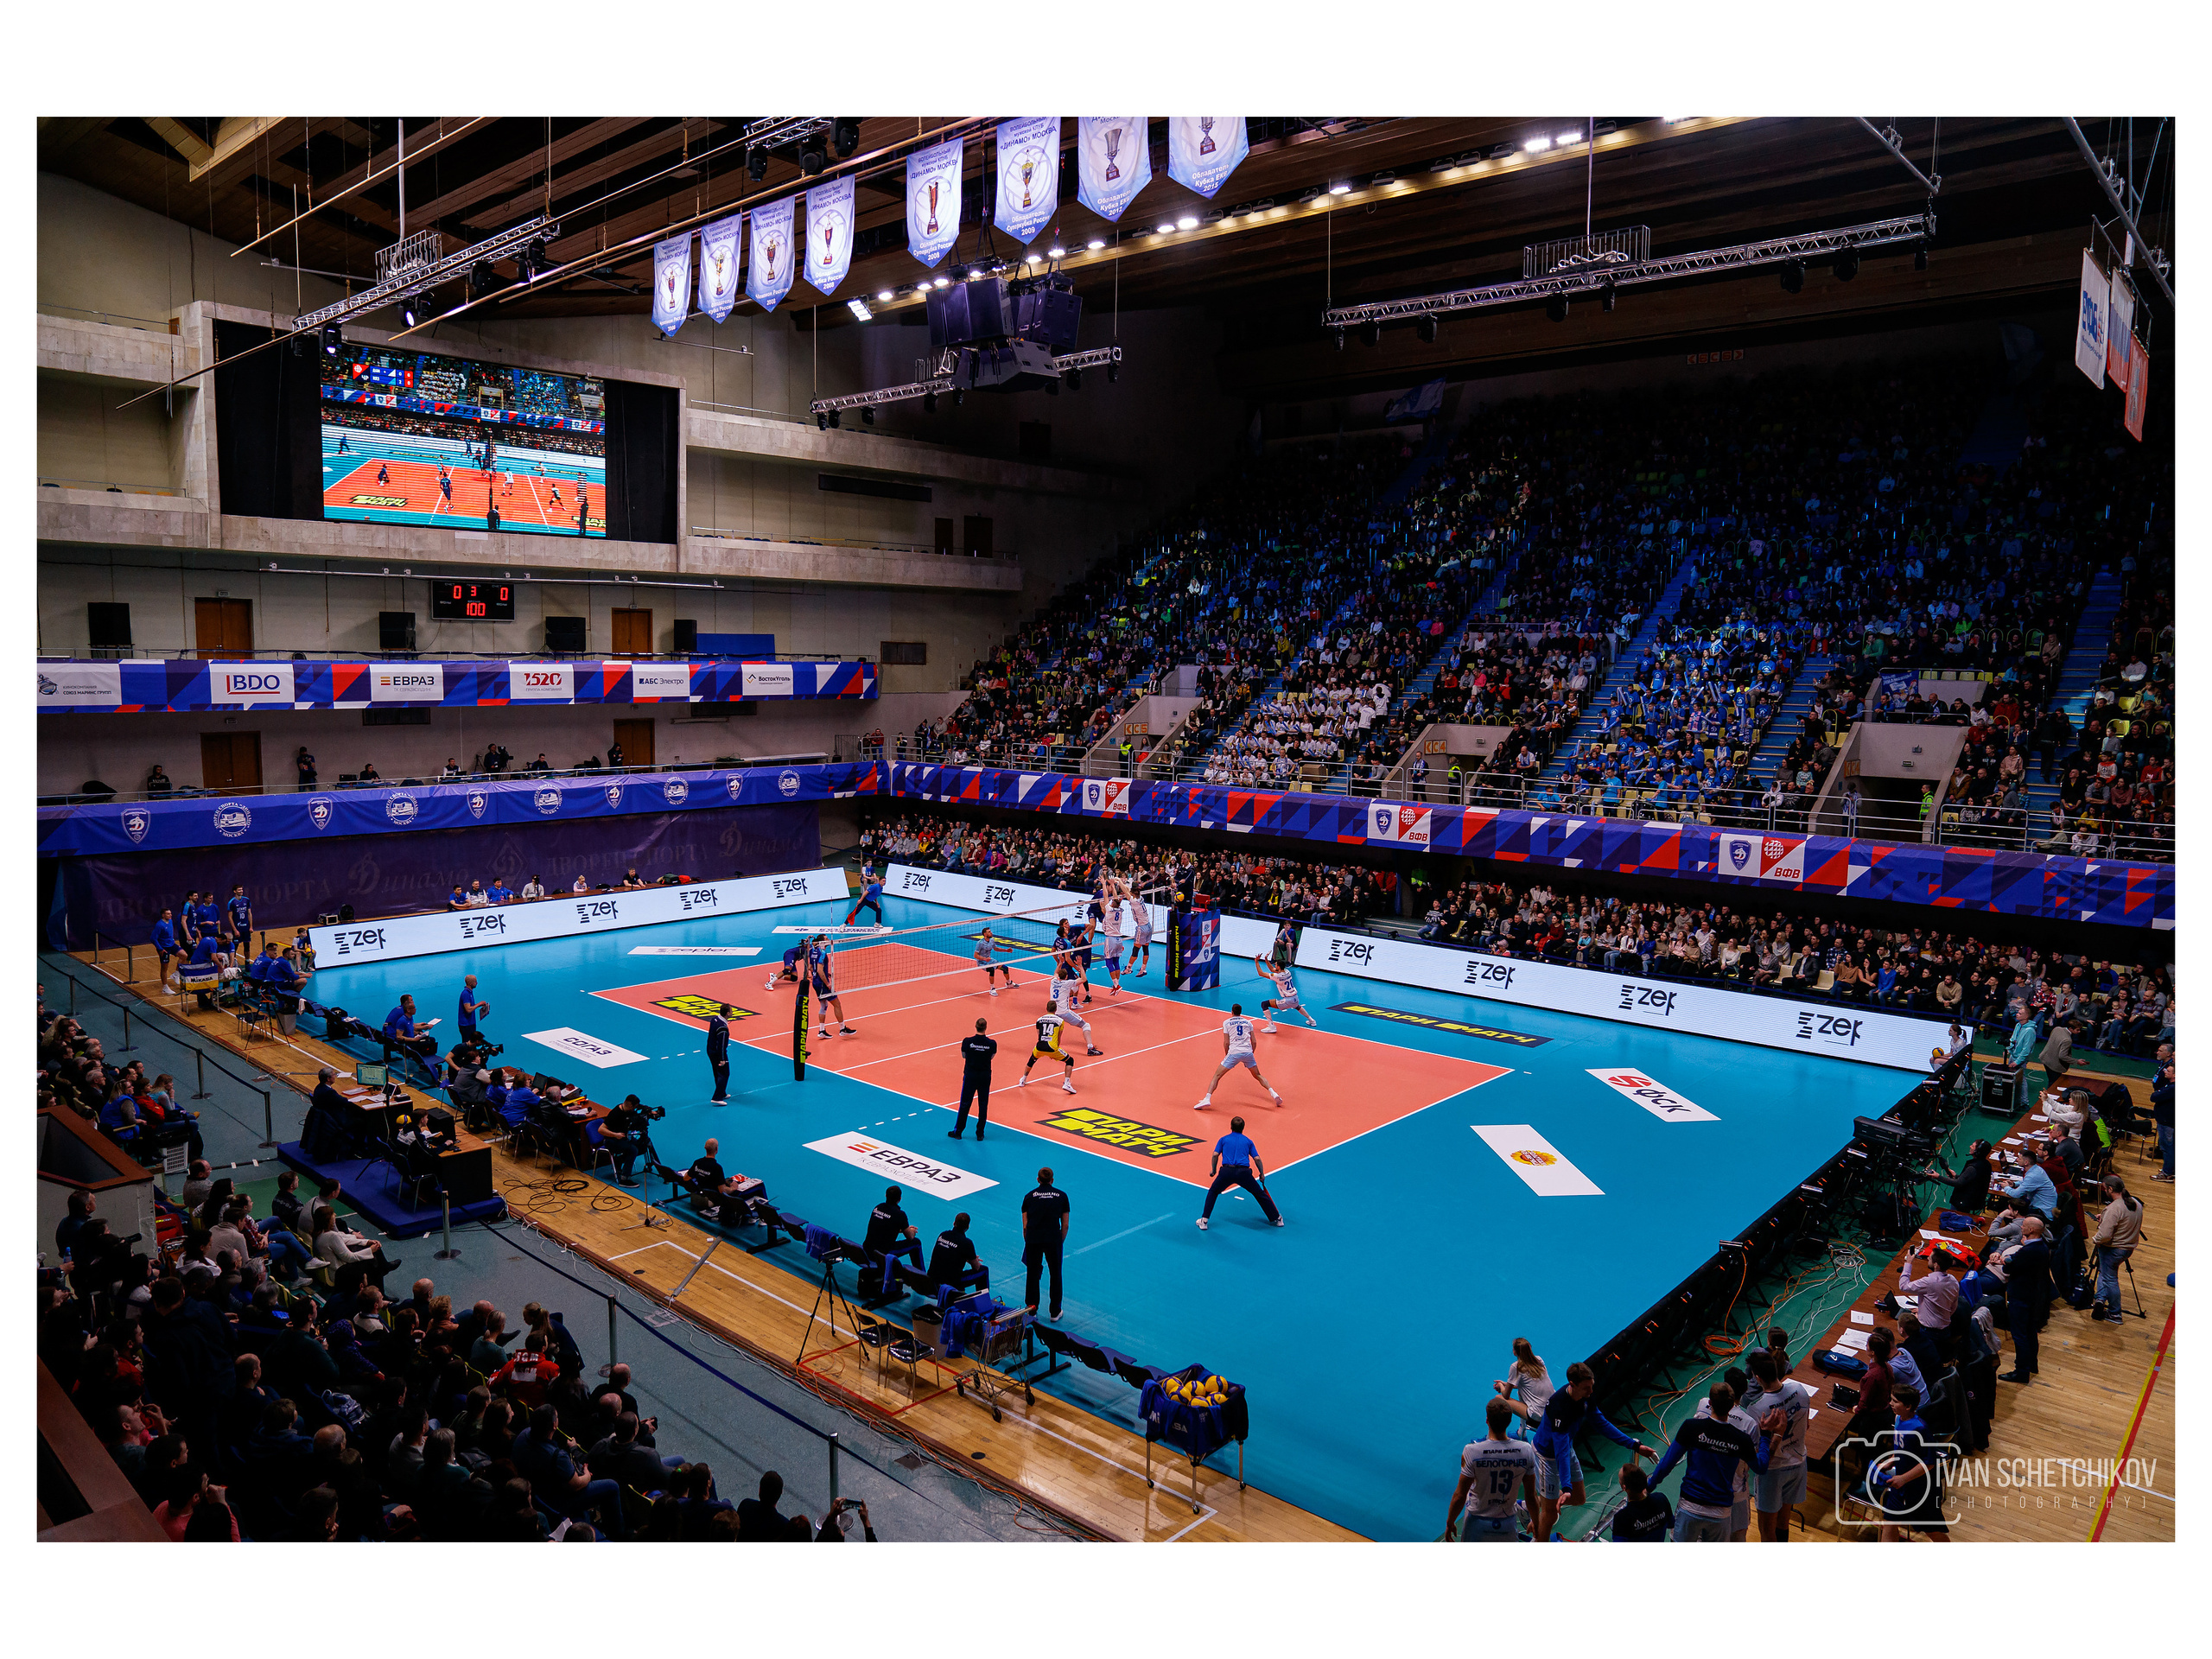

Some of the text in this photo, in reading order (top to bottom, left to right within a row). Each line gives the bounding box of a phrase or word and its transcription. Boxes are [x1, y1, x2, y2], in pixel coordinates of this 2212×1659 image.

[1033, 125, 1057, 140] МОСКВА
[1192, 164, 1229, 180] Обладатель
[1195, 176, 1215, 188] Кубка
[1203, 181, 1218, 192] 2015
[1097, 190, 1132, 204] Обладатель
[1100, 201, 1119, 212] Кубка
[1108, 207, 1122, 216] 2012
[1012, 211, 1046, 223] Обладатель
[1021, 226, 1035, 236] 2009
[927, 251, 940, 261] 2008
[453, 585, 508, 601] 0 3 0
[467, 602, 486, 616] 100
[232, 674, 281, 691] BDO
[393, 676, 435, 686] ЕВРАЗ
[524, 672, 562, 686] 1520
[1134, 724, 1147, 734] С5
[1433, 741, 1446, 752] С4
[1408, 832, 1428, 842] ВФВ
[1774, 868, 1801, 879] ВФВ
[1115, 912, 1119, 921] 8
[1052, 989, 1058, 999] 3
[1042, 1024, 1053, 1035] 14
[1343, 1006, 1537, 1042] ПАРИ МАТЧ
[1236, 1026, 1243, 1036] 9
[563, 1036, 612, 1055] СОГАЗ
[1632, 1089, 1691, 1113] ФСК
[1061, 1109, 1193, 1146] ПАРИ
[1046, 1118, 1180, 1156] МАТЧ
[868, 1150, 961, 1183] ЕВРАЗ
[1554, 1418, 1561, 1427] 17
[1698, 1433, 1738, 1451] Динамо
[1476, 1458, 1528, 1469] БЕЛОГОРЦЕВ
[1490, 1470, 1514, 1495] 13
[1548, 1484, 1554, 1492] 17
[1634, 1511, 1666, 1530] Динамо
